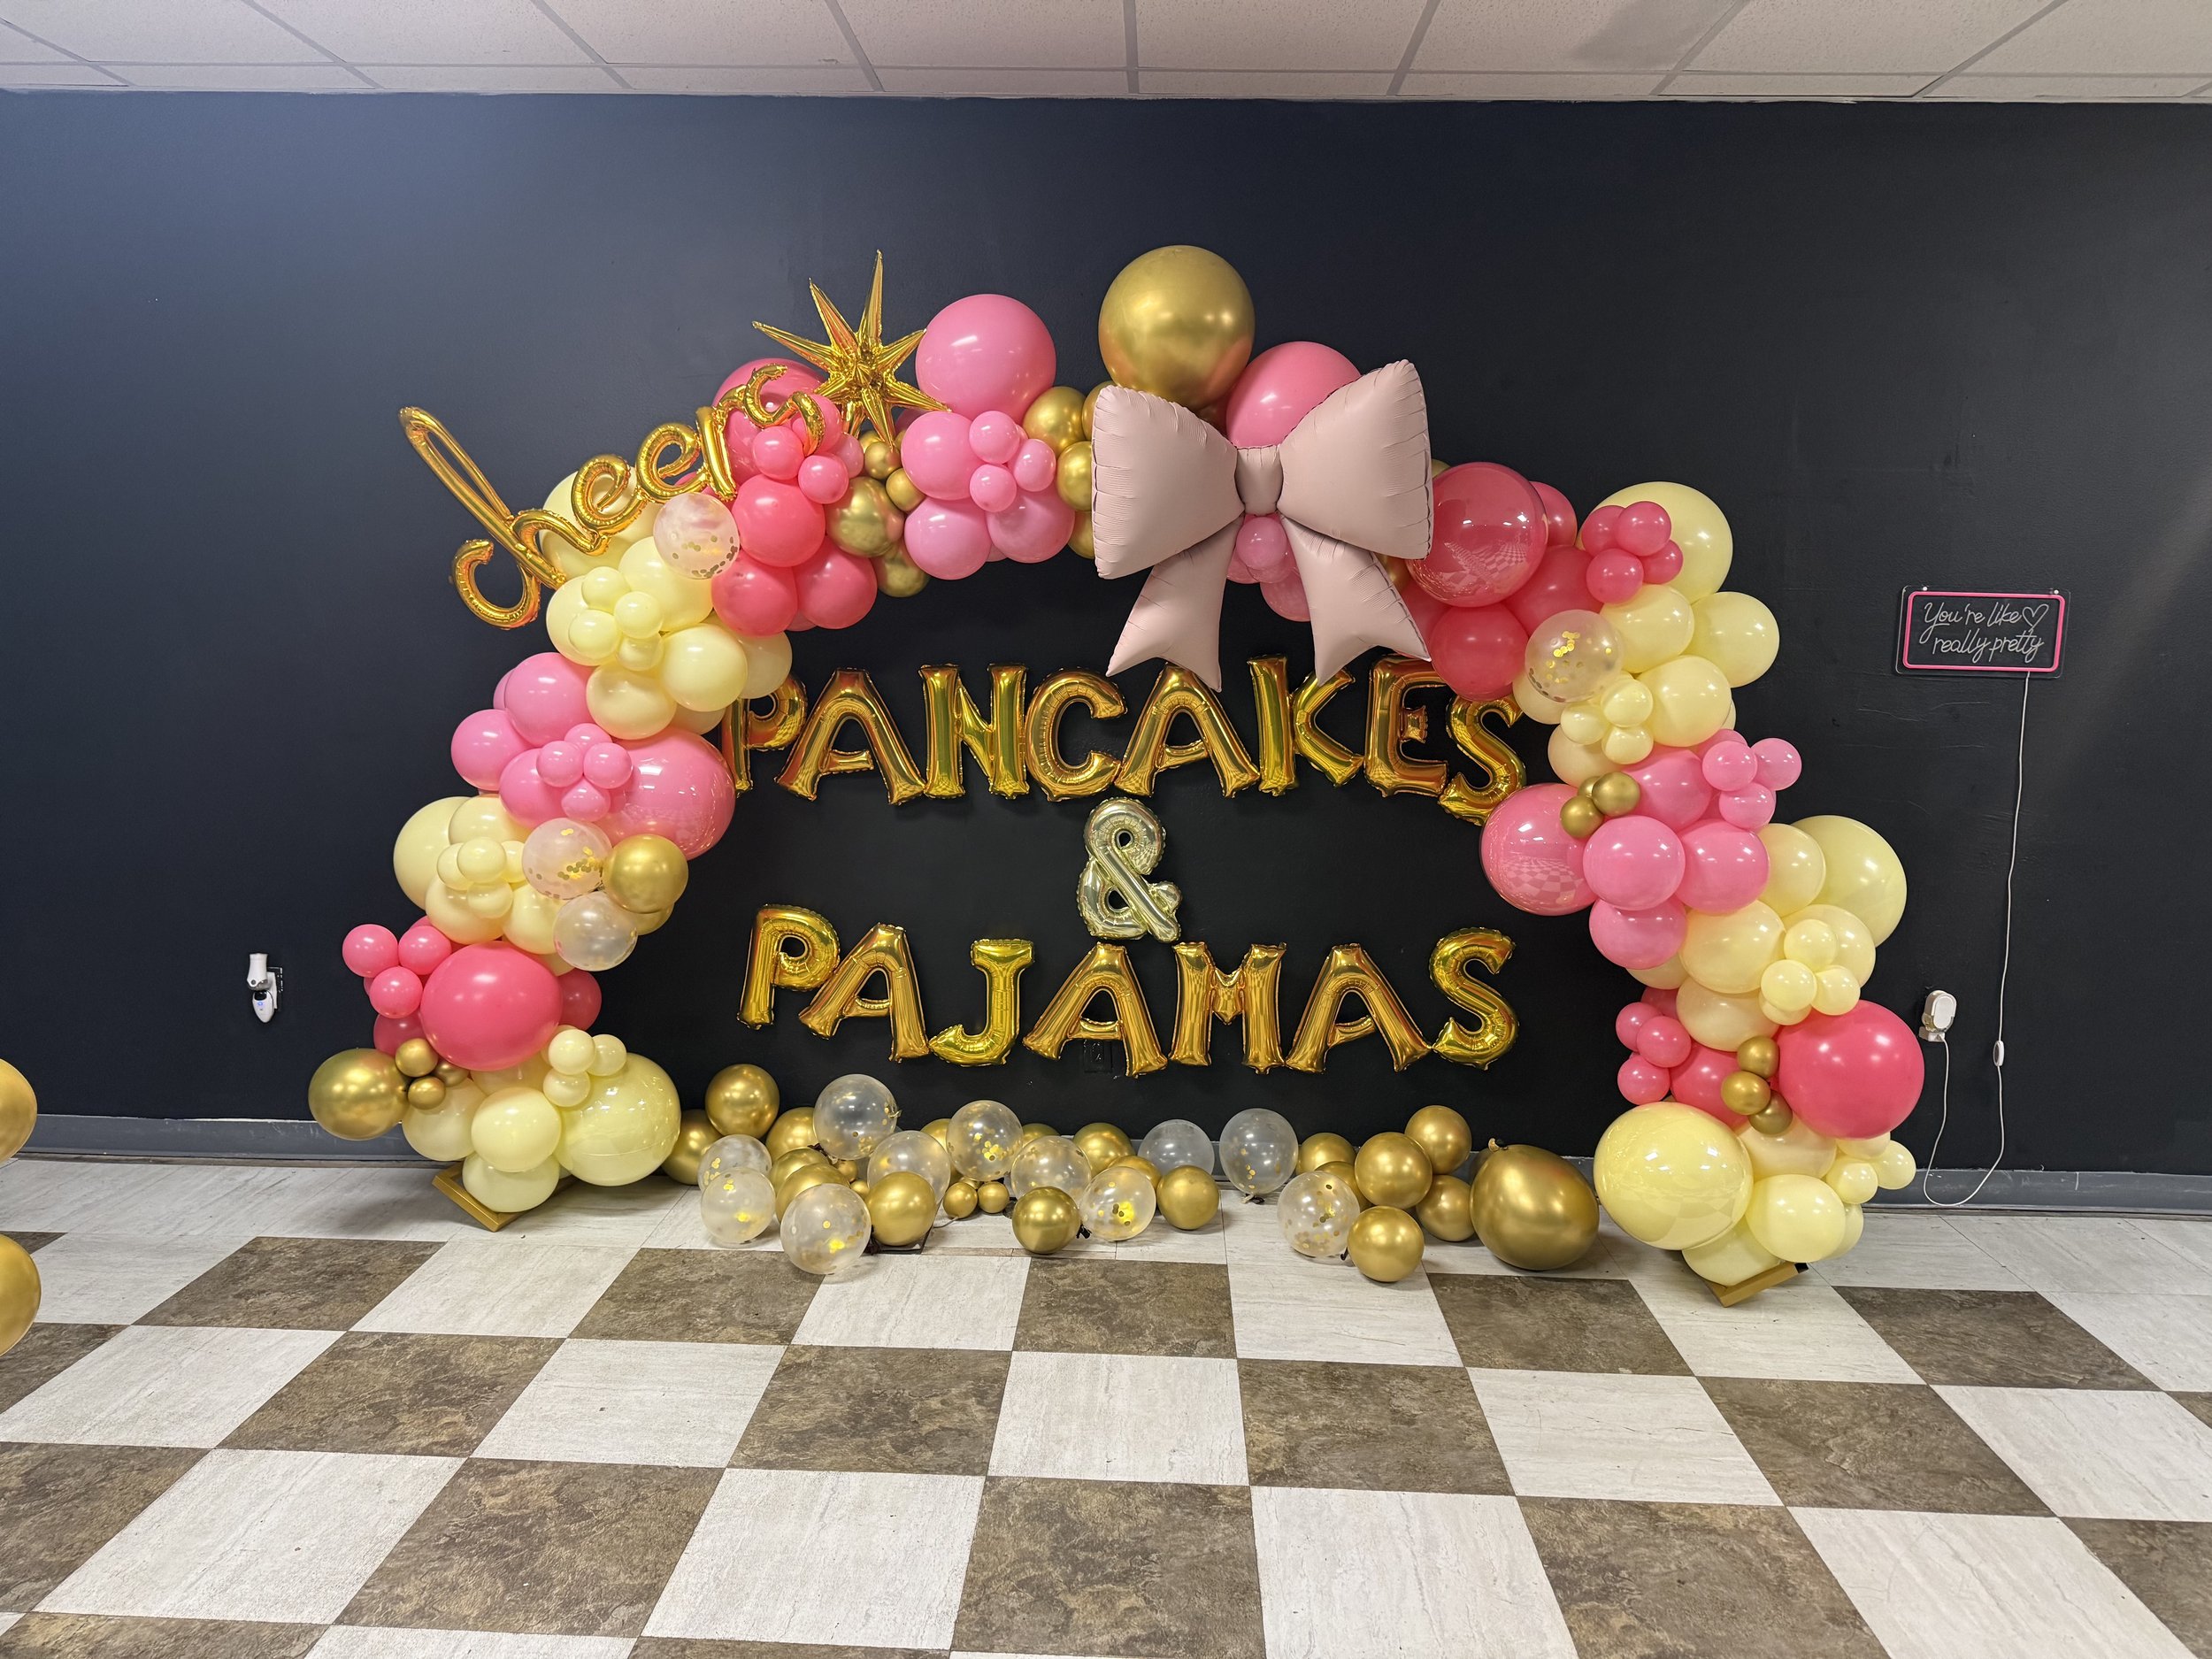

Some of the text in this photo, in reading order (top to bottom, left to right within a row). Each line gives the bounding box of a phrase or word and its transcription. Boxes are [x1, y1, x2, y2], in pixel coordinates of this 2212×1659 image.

[1918, 602, 2023, 644] You're like
[1932, 627, 2046, 664] really pretty
[721, 653, 1528, 826] PANCAKES
[1076, 796, 1183, 943] &
[736, 903, 1522, 1077] PAJAMAS
